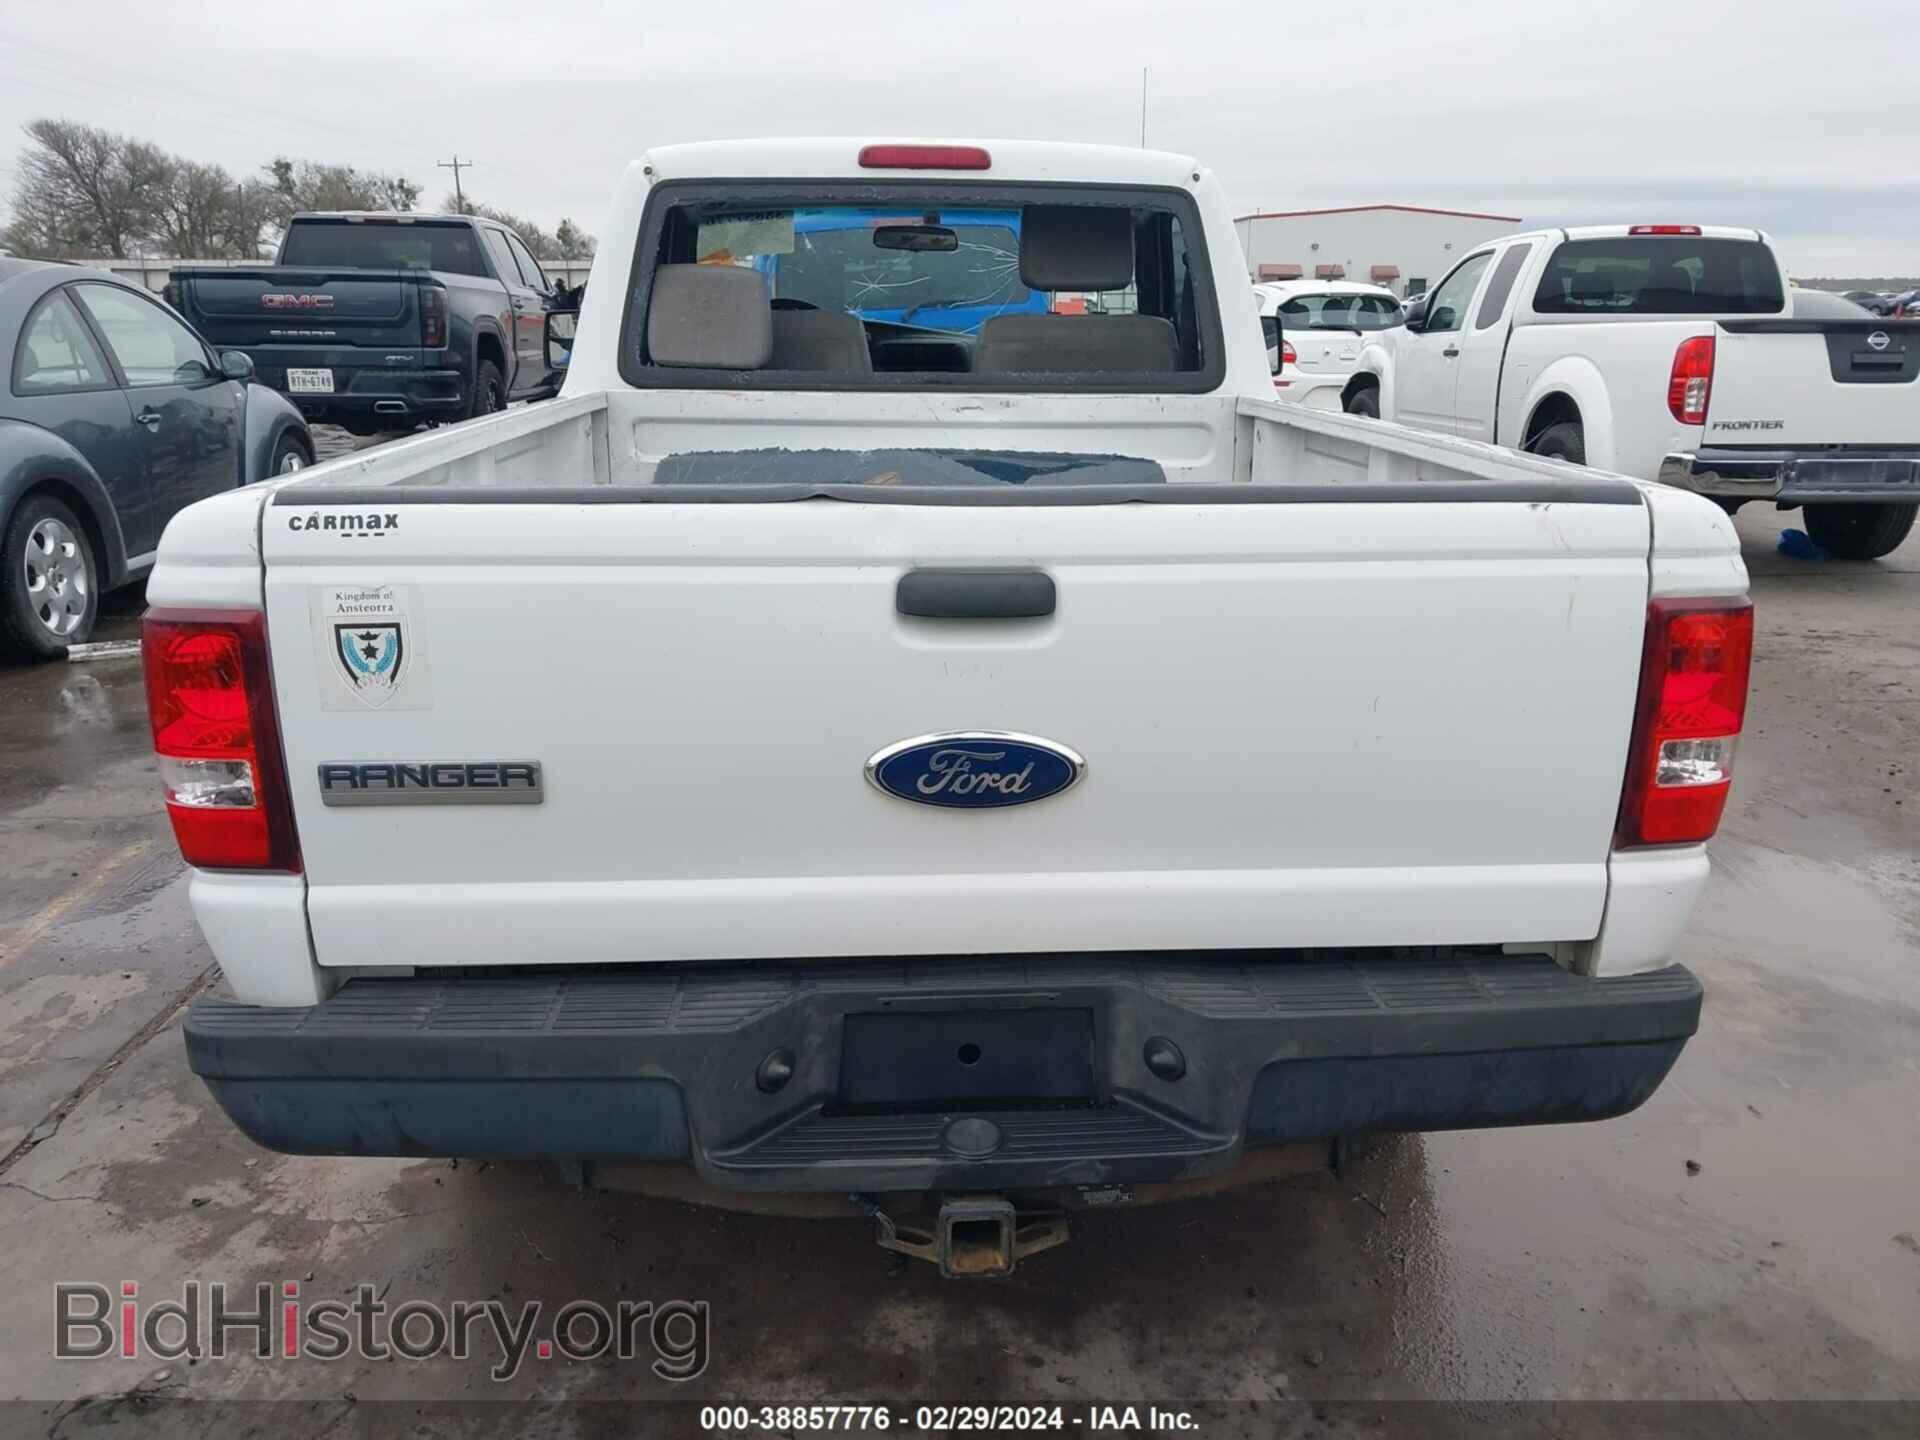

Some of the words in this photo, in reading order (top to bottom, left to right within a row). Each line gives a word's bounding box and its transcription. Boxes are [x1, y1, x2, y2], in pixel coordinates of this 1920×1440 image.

[261, 294, 335, 309] GMC
[1712, 420, 1784, 430] FRONTIER
[335, 592, 380, 603] Kingdom
[336, 603, 394, 613] Ansteorra
[323, 763, 536, 790] RANGER
[917, 748, 1034, 795] Ford
